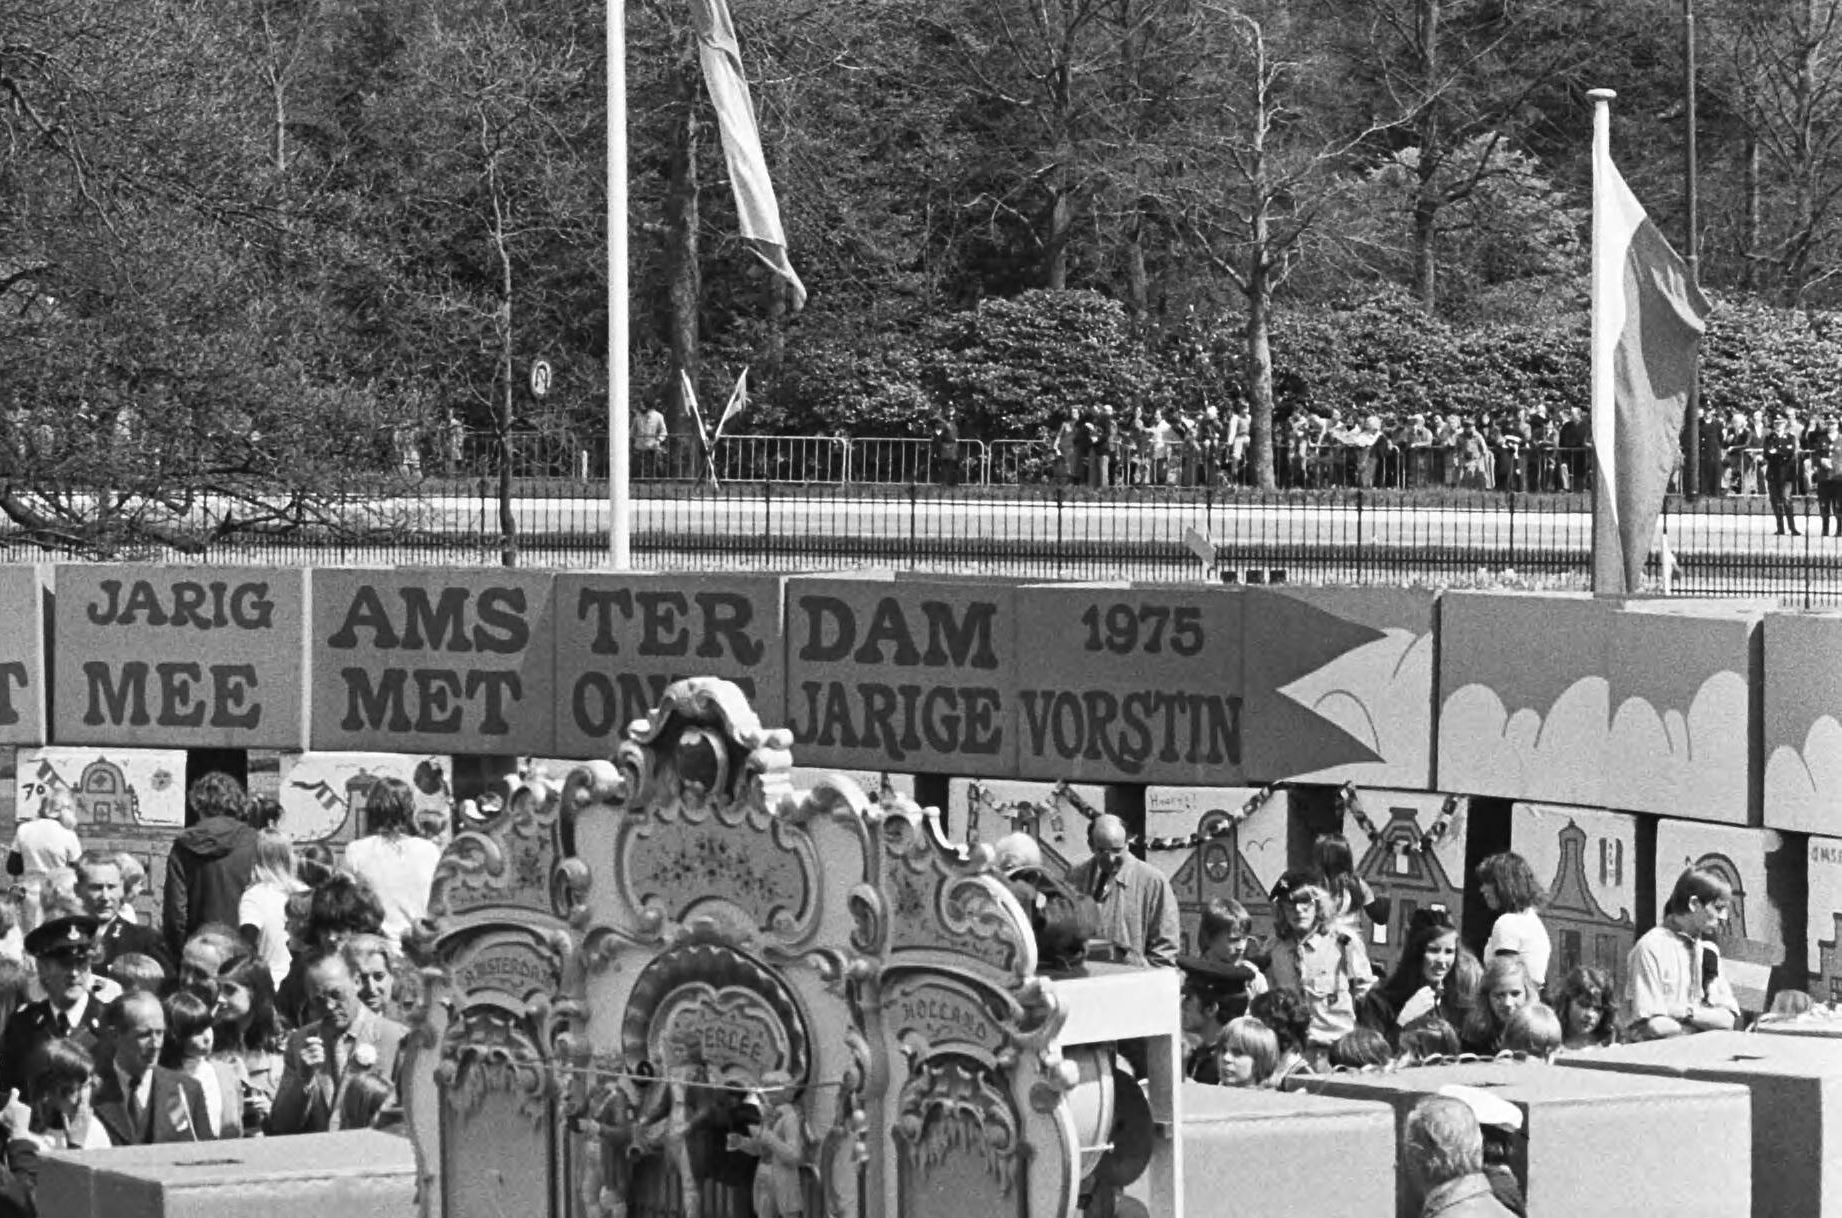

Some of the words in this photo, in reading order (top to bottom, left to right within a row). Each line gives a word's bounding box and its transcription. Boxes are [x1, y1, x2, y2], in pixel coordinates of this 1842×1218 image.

[86, 580, 275, 630] JARIG
[327, 585, 530, 654] AMS
[577, 587, 764, 666] TER
[799, 595, 999, 670] DAM
[1081, 603, 1204, 656] 1975
[82, 661, 261, 730] MEE
[340, 667, 522, 734] MET
[572, 671, 756, 739] ON
[789, 680, 1001, 761] JARIGE
[1017, 689, 1243, 774] VORSTIN
[695, 1023, 764, 1062] ERLEE
[901, 998, 987, 1040] HOLLAND
